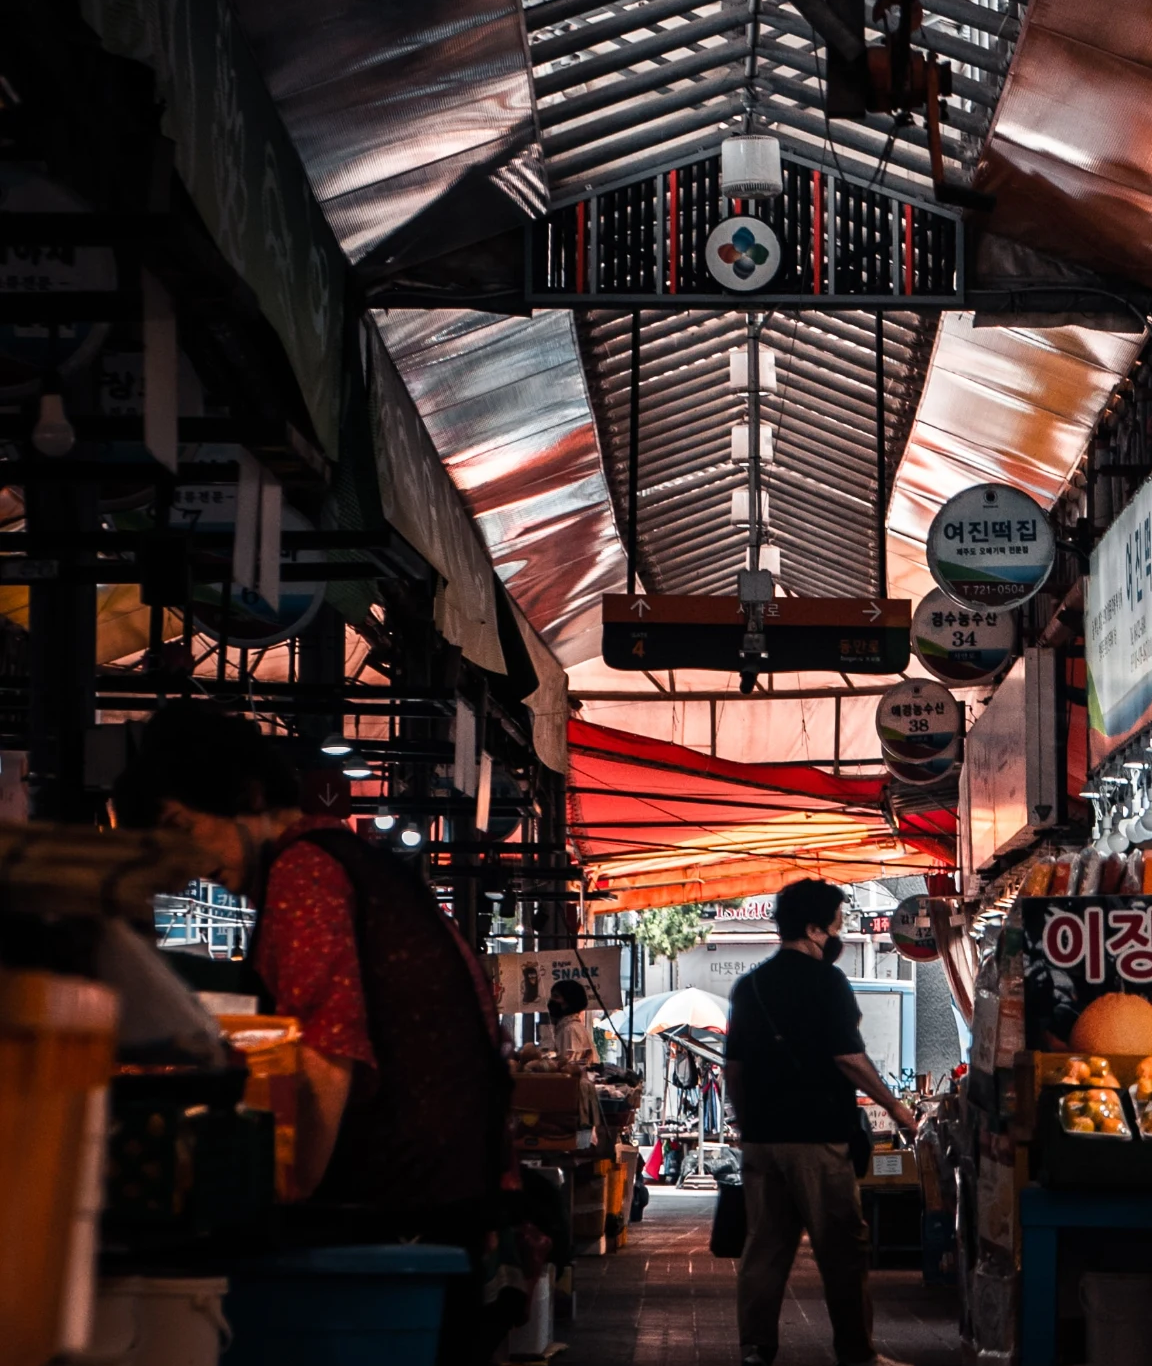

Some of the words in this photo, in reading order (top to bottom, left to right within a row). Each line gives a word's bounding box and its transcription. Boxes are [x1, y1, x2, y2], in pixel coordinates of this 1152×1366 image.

[943, 519, 1037, 543] 여진떡집
[957, 547, 976, 556] 제주도
[962, 585, 1025, 596] T.721-0504
[952, 631, 977, 647] 34
[632, 638, 646, 658] 4
[909, 719, 929, 732] 38
[710, 962, 746, 976] 따뜻한
